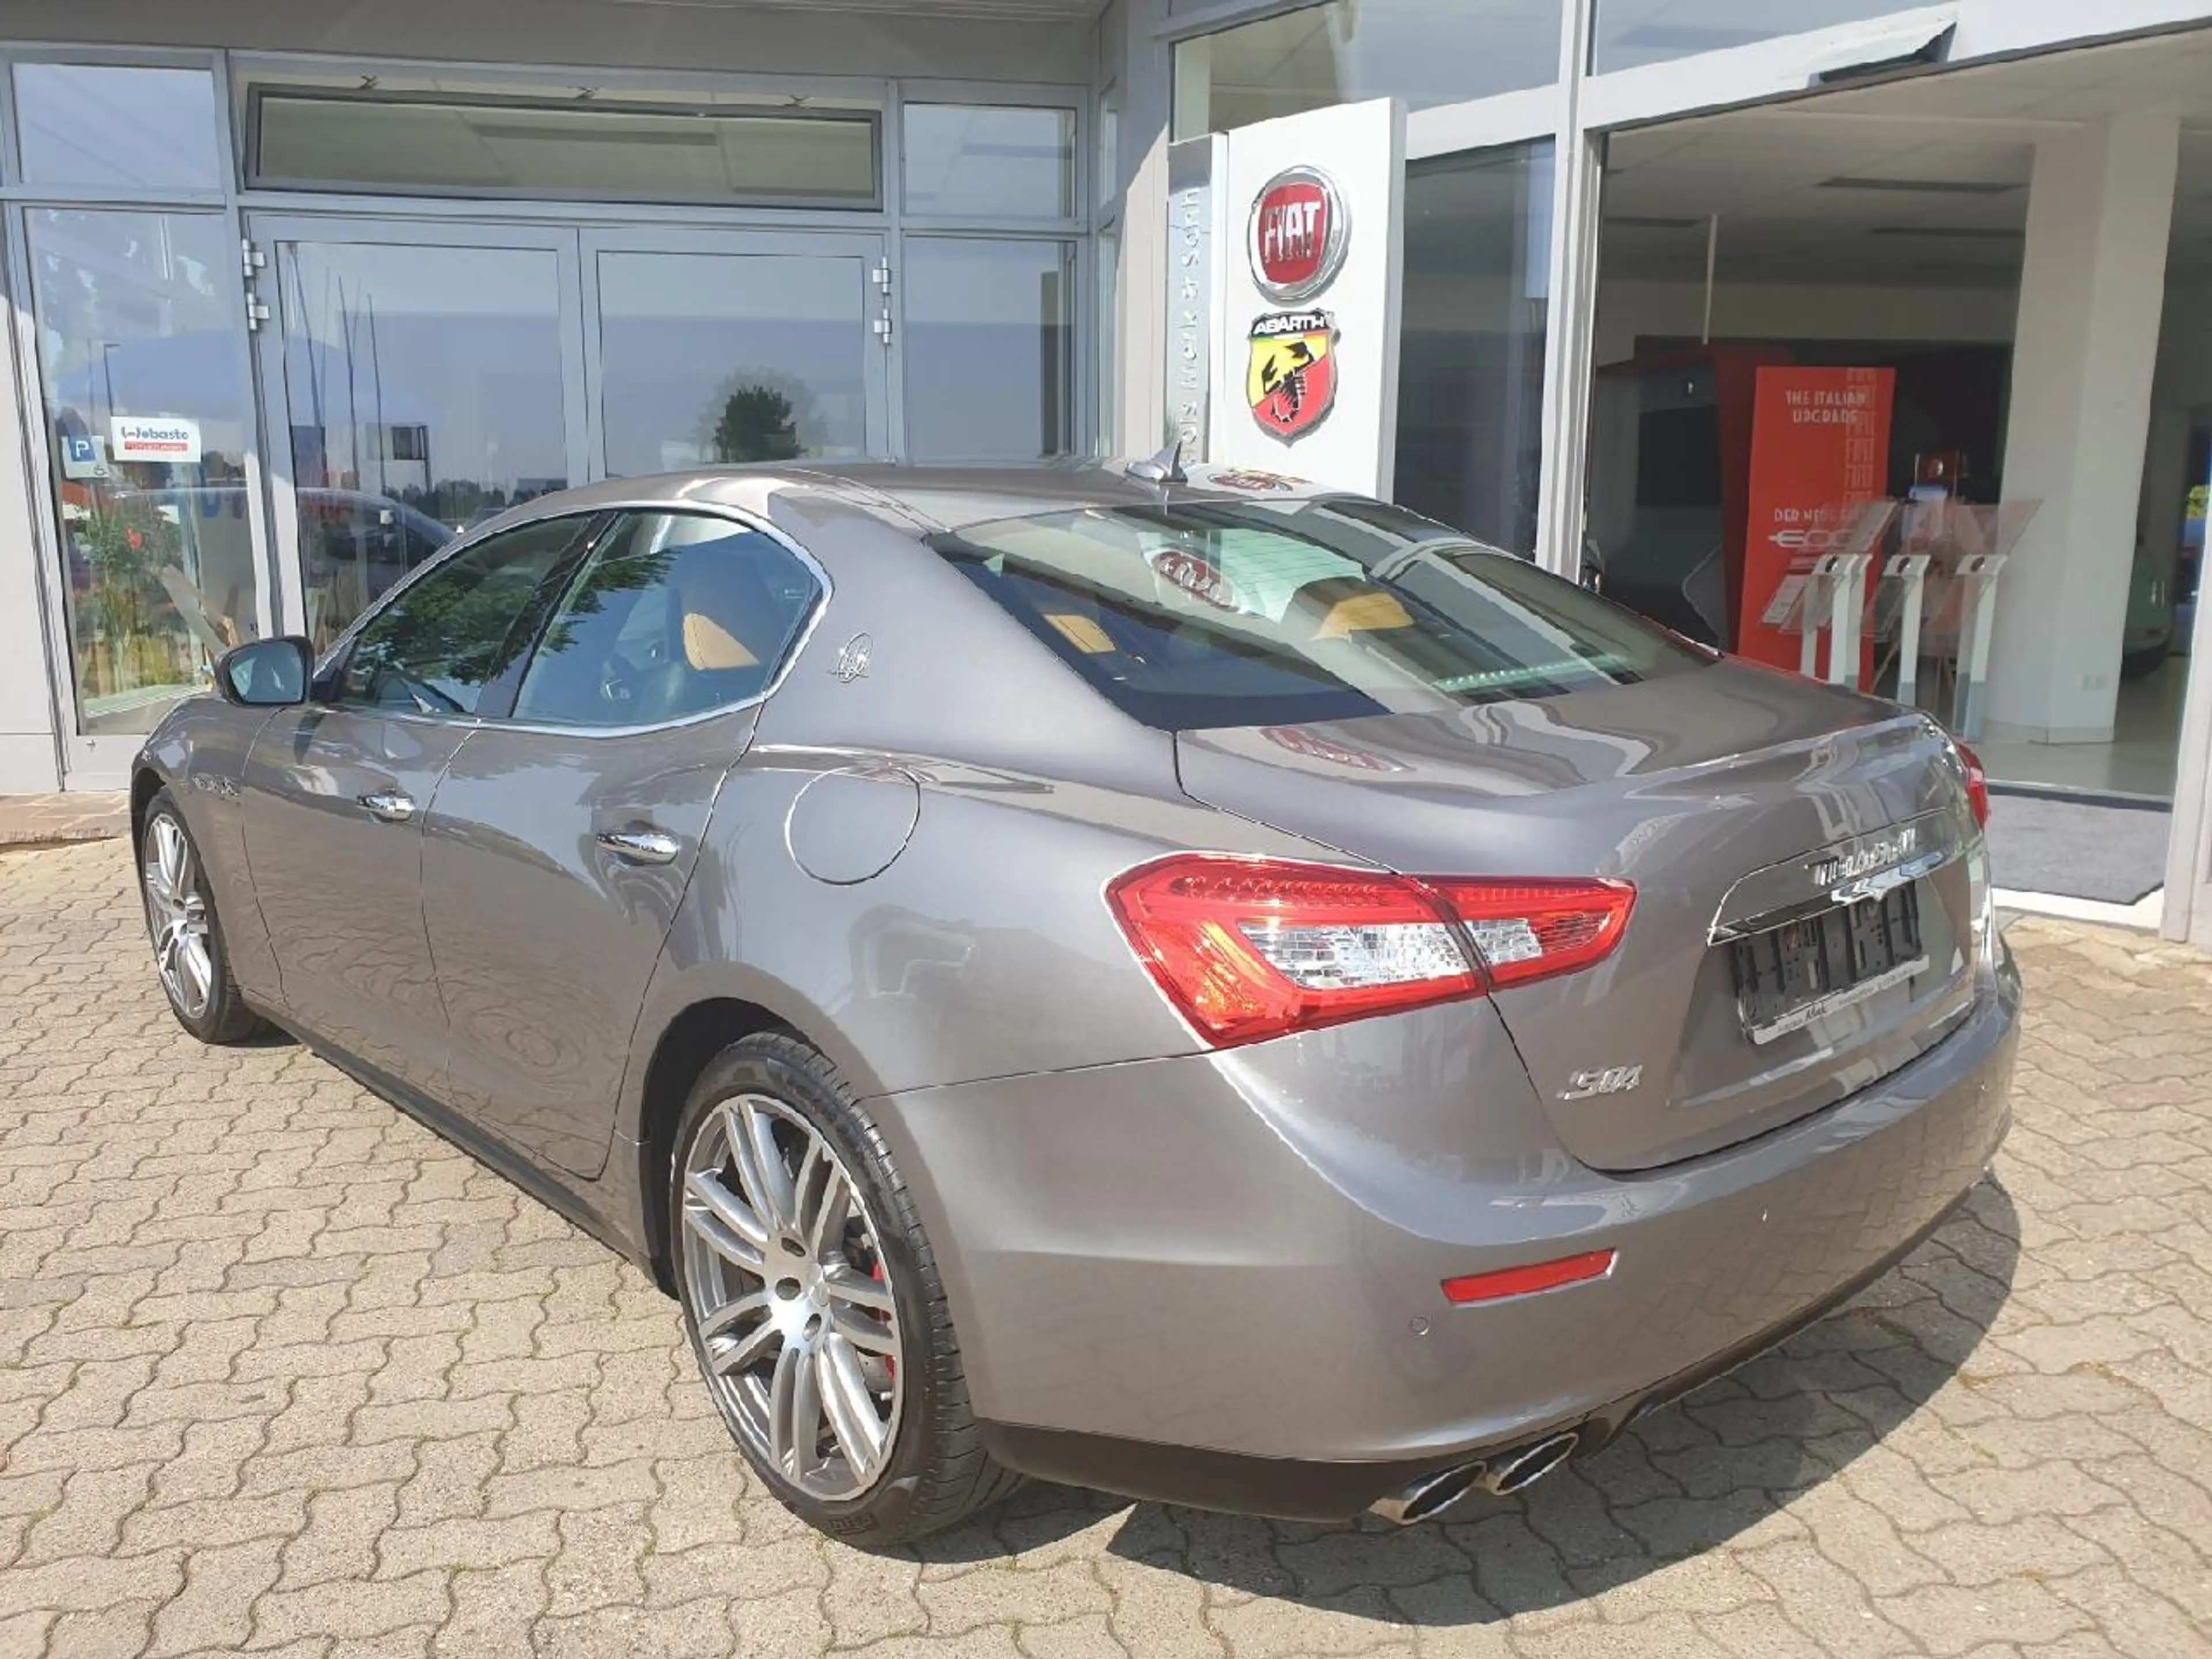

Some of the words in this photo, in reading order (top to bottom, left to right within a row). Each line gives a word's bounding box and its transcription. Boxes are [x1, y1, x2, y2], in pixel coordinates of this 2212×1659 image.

[1265, 200, 1321, 263] FIAT
[1253, 315, 1326, 335] ABARTH
[1785, 391, 1809, 406] THE
[75, 441, 89, 458] P
[1774, 507, 1799, 521] DER
